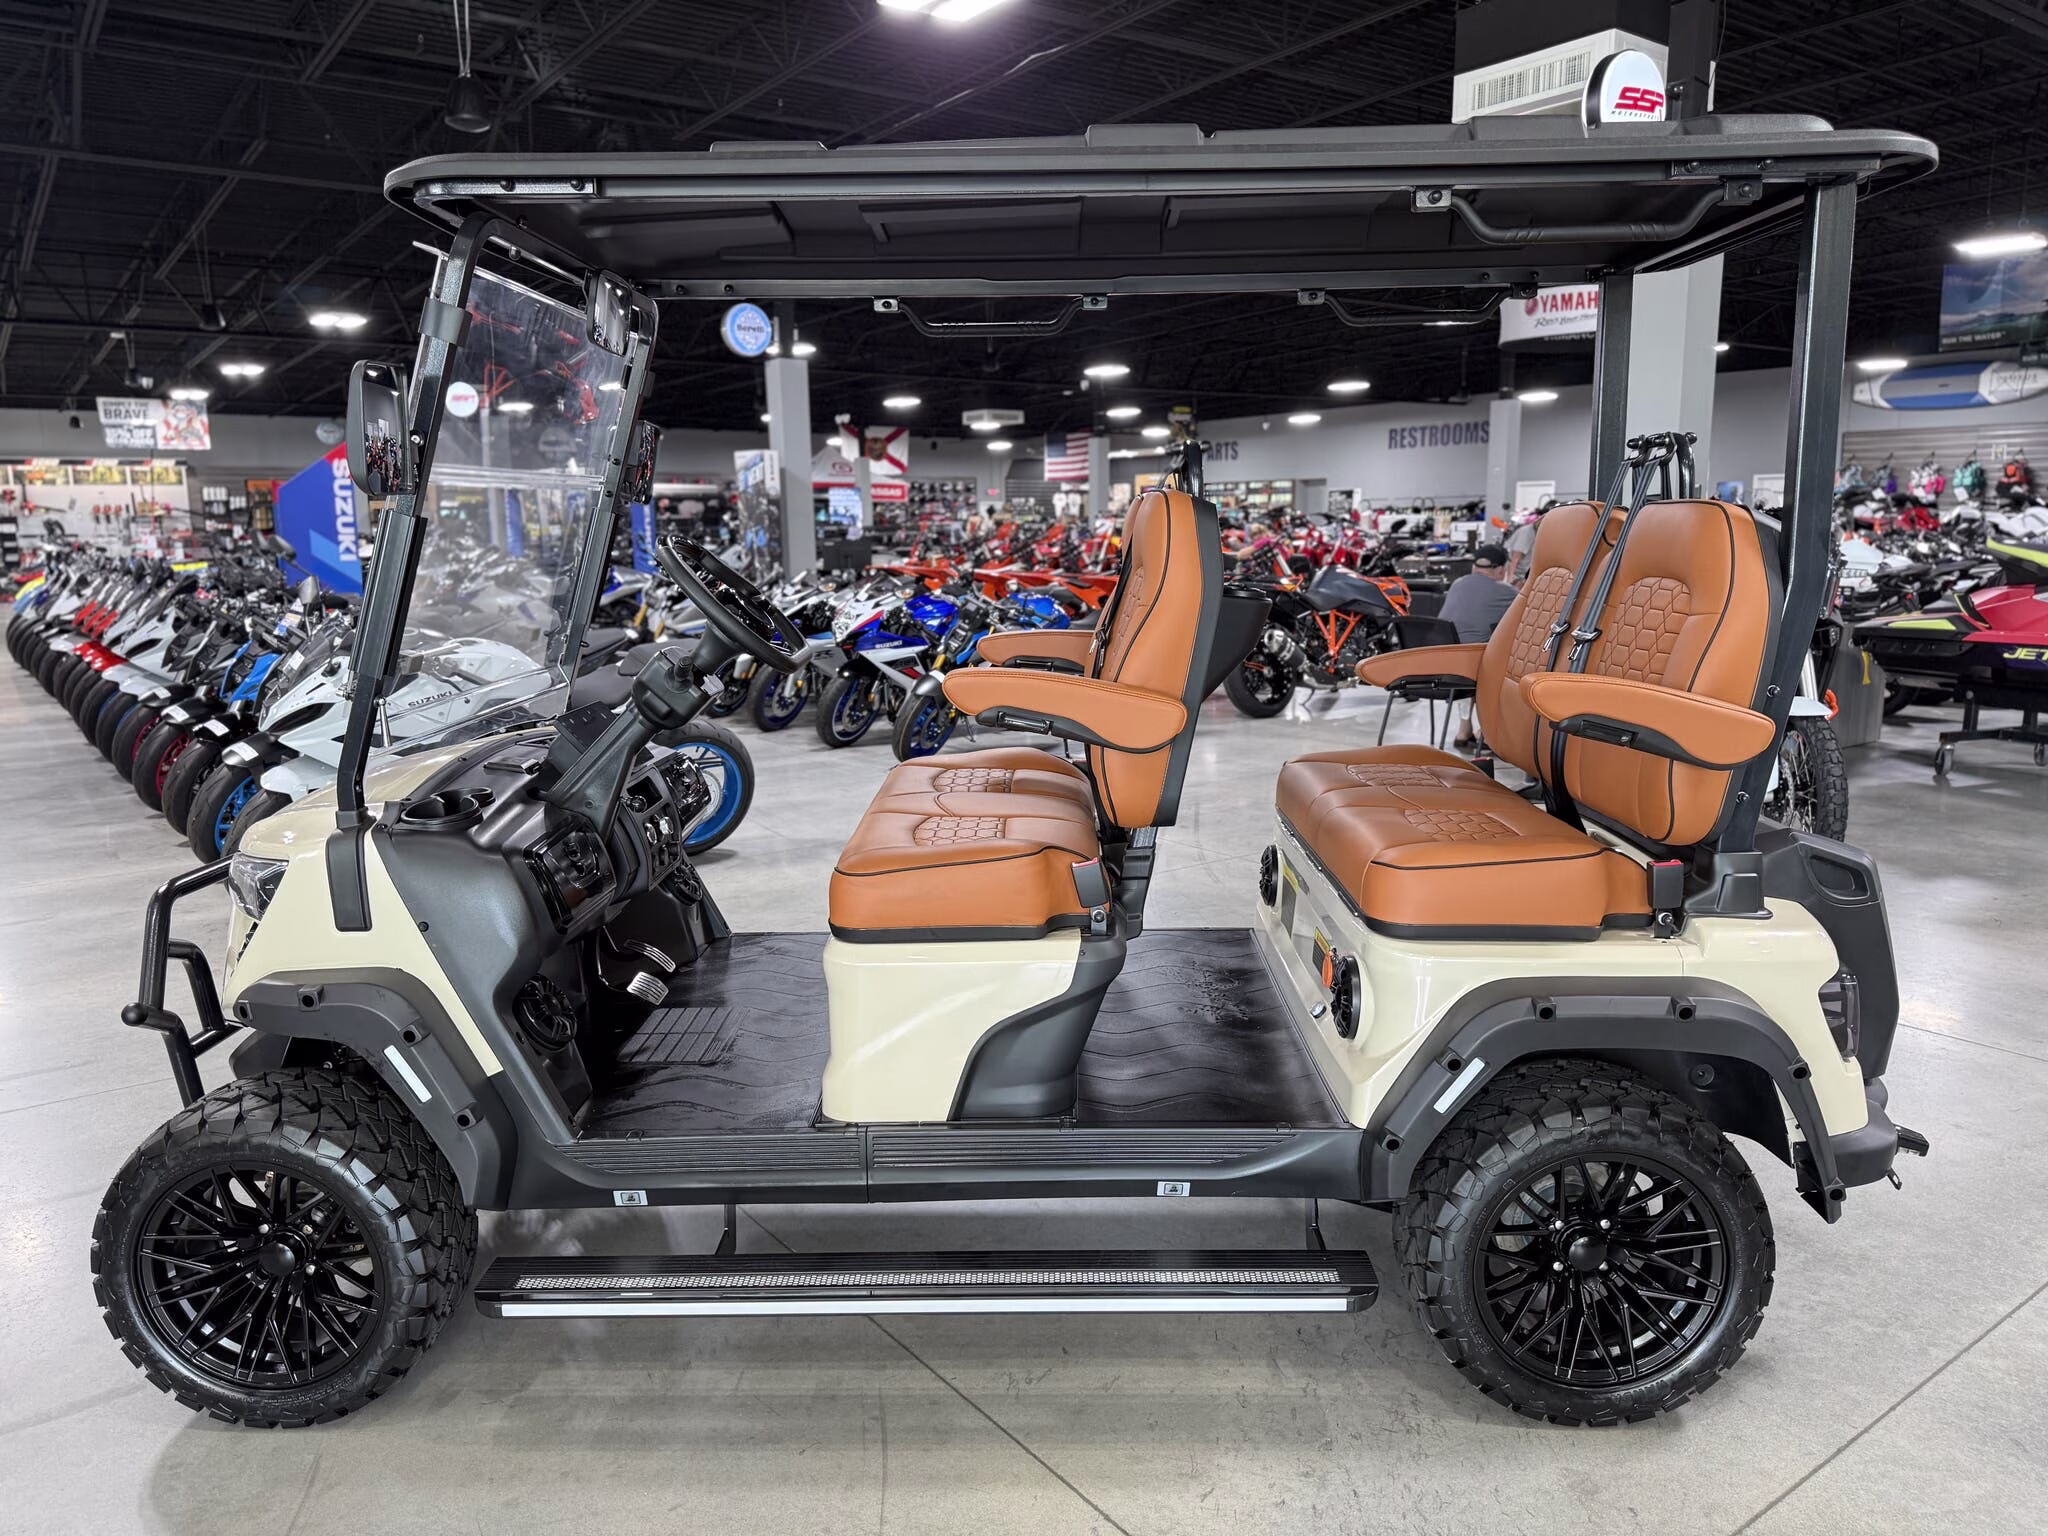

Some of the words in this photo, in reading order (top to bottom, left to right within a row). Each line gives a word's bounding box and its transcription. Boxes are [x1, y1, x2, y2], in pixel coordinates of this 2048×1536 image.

[1540, 291, 1598, 313] YAMAH
[103, 408, 149, 420] BRAVE
[1388, 420, 1490, 449] RESTROOMS
[1207, 441, 1239, 461] ARTS
[332, 458, 357, 561] SUZUKI
[874, 640, 903, 649] SUZUKI
[408, 690, 453, 707] SUZUKI
